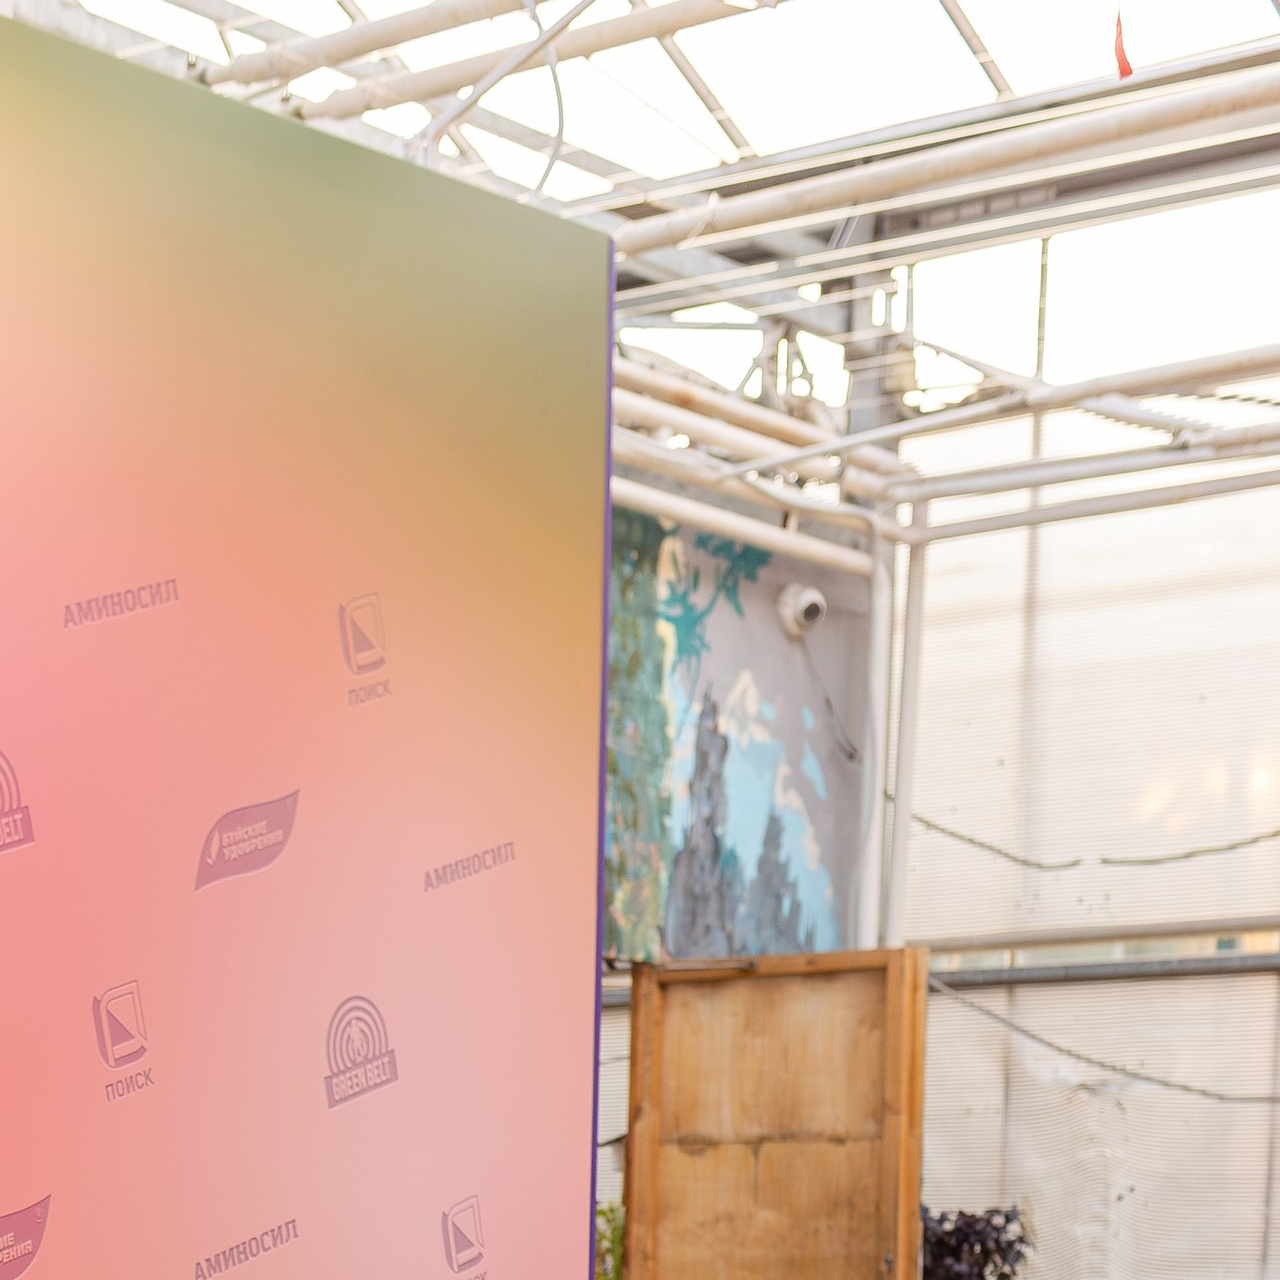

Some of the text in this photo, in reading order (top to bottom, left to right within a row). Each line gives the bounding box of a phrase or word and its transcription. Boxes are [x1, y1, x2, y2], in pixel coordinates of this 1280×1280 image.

[63, 579, 179, 629] АМИНОСИЛ
[423, 842, 516, 893] АМИНОСИЛ
[105, 1068, 155, 1102] ПОИСК
